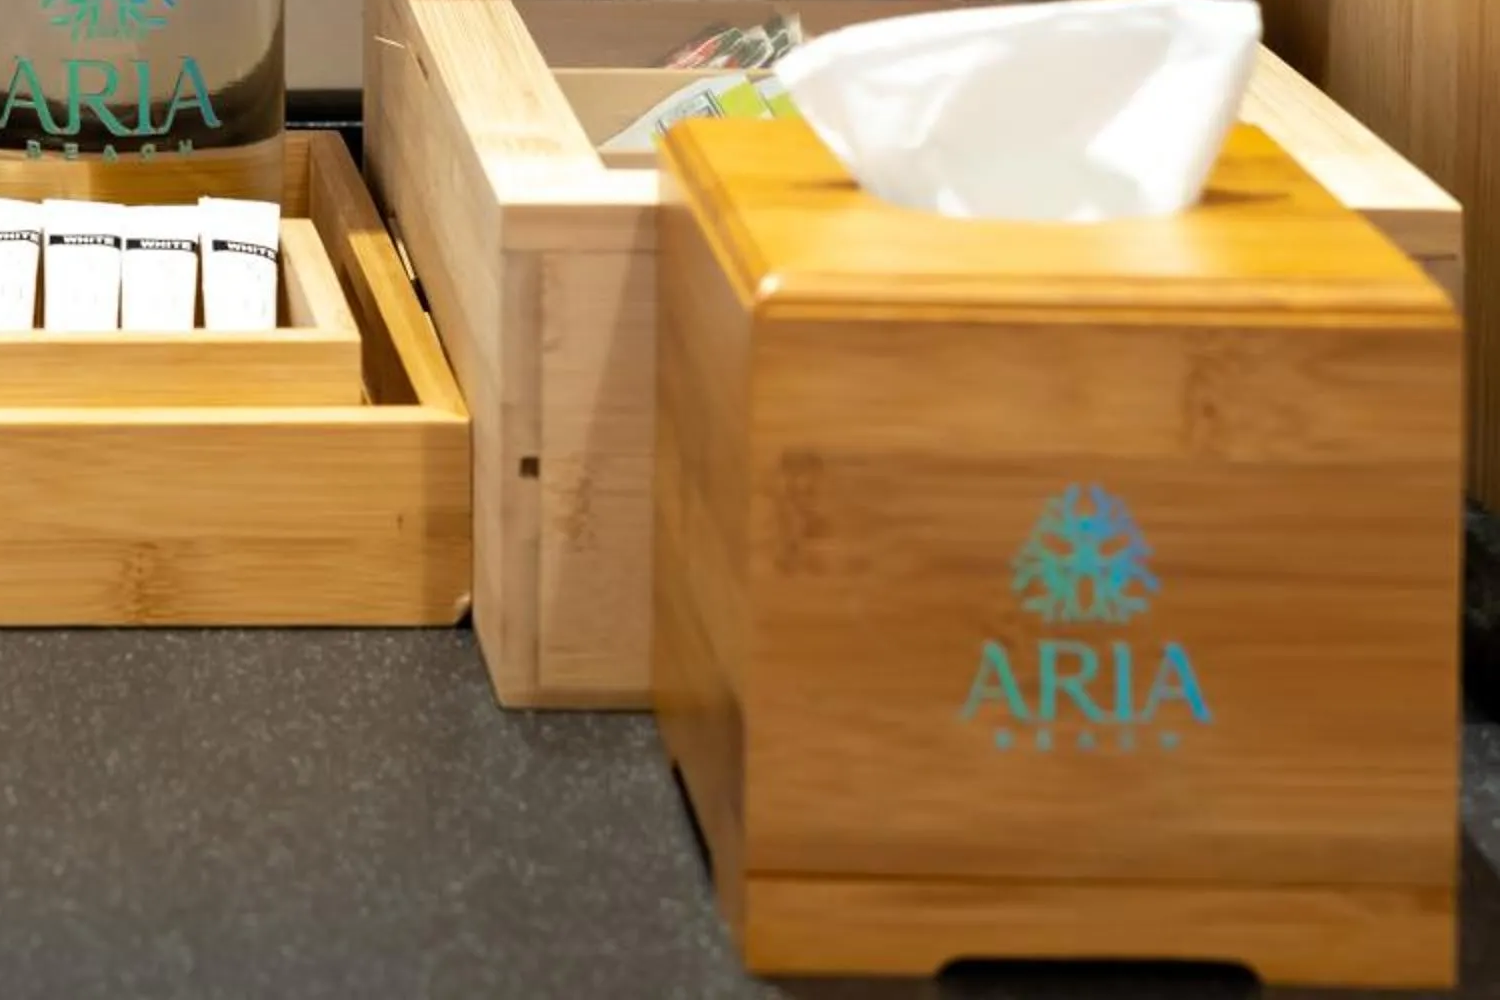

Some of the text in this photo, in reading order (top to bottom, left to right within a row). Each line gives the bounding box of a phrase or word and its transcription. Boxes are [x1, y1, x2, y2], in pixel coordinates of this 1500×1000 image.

[26, 139, 193, 161] BEACH
[63, 234, 115, 246] WHITE
[140, 239, 191, 250] WHITE
[960, 639, 1212, 724] ARIA
